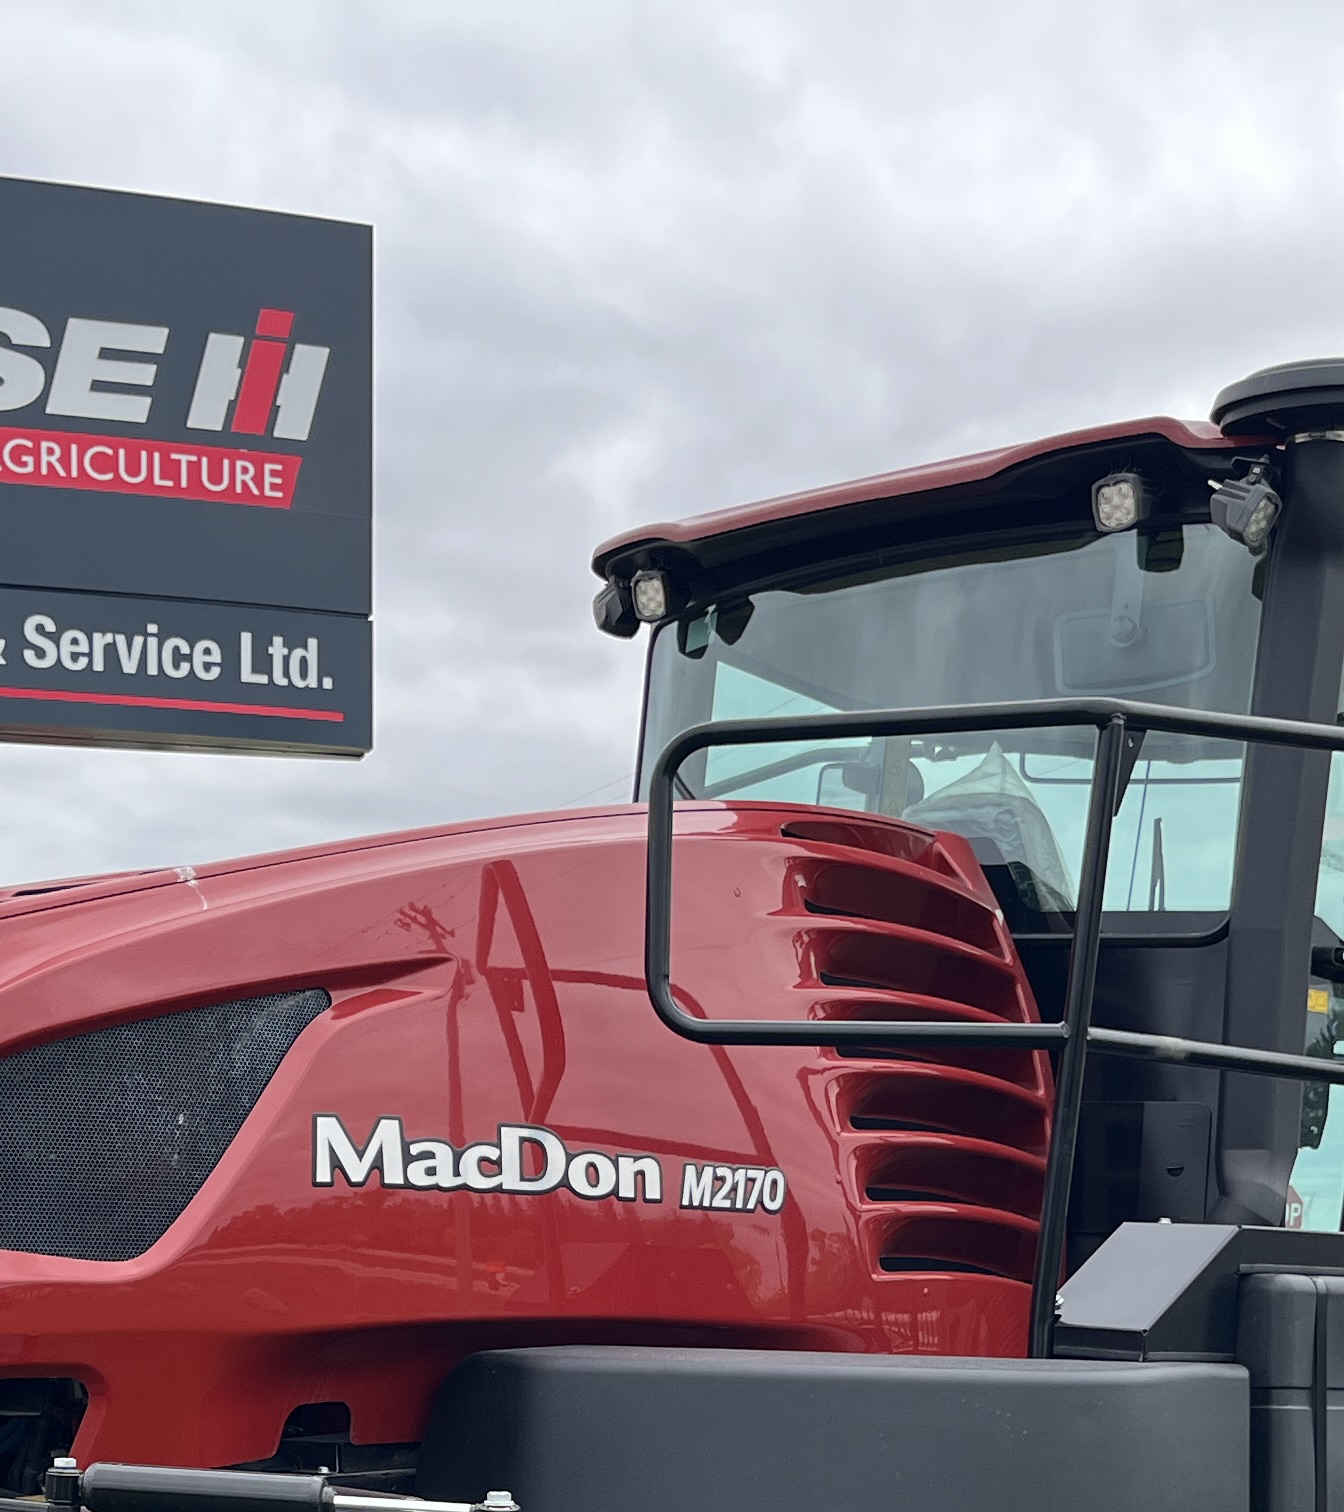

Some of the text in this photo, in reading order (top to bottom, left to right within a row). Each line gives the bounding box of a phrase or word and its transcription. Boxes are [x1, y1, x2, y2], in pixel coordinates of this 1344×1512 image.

[22, 613, 223, 682] Service
[239, 630, 334, 691] Ltd.
[313, 1114, 786, 1214] MacDon M2170
